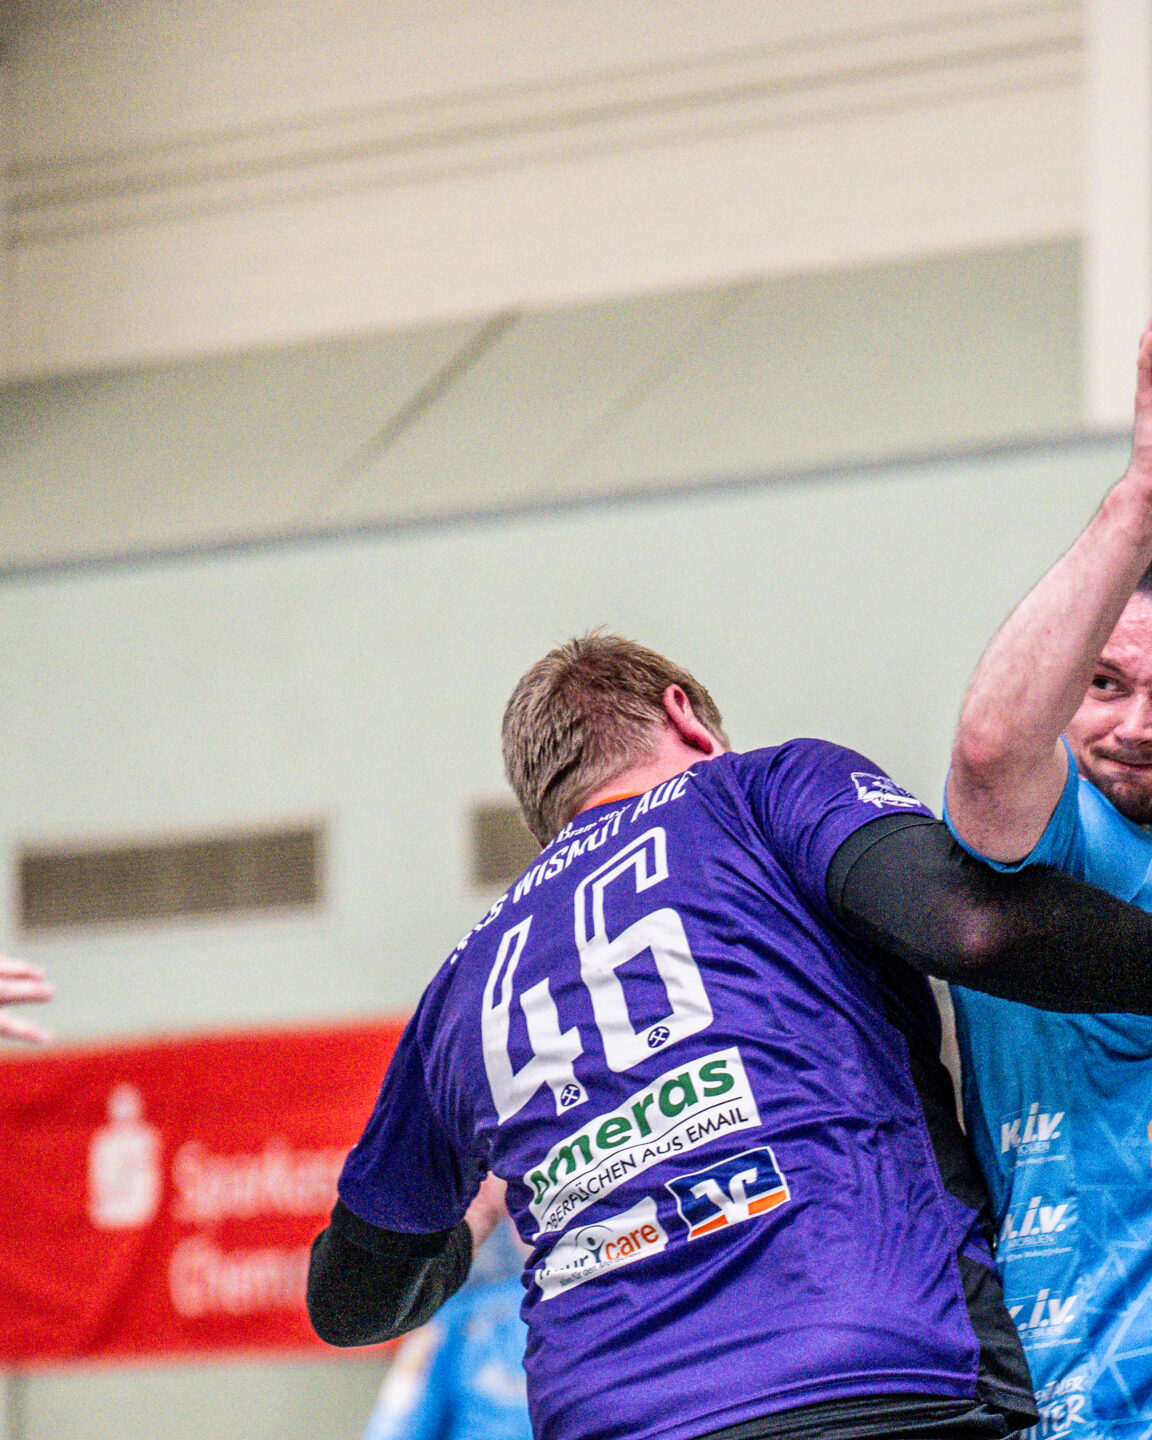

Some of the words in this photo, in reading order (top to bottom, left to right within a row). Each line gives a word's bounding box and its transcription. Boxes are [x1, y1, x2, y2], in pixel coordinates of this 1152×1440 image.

[481, 827, 714, 1126] 46
[642, 1136, 683, 1163] AUS
[687, 1107, 749, 1143] EMAIL
